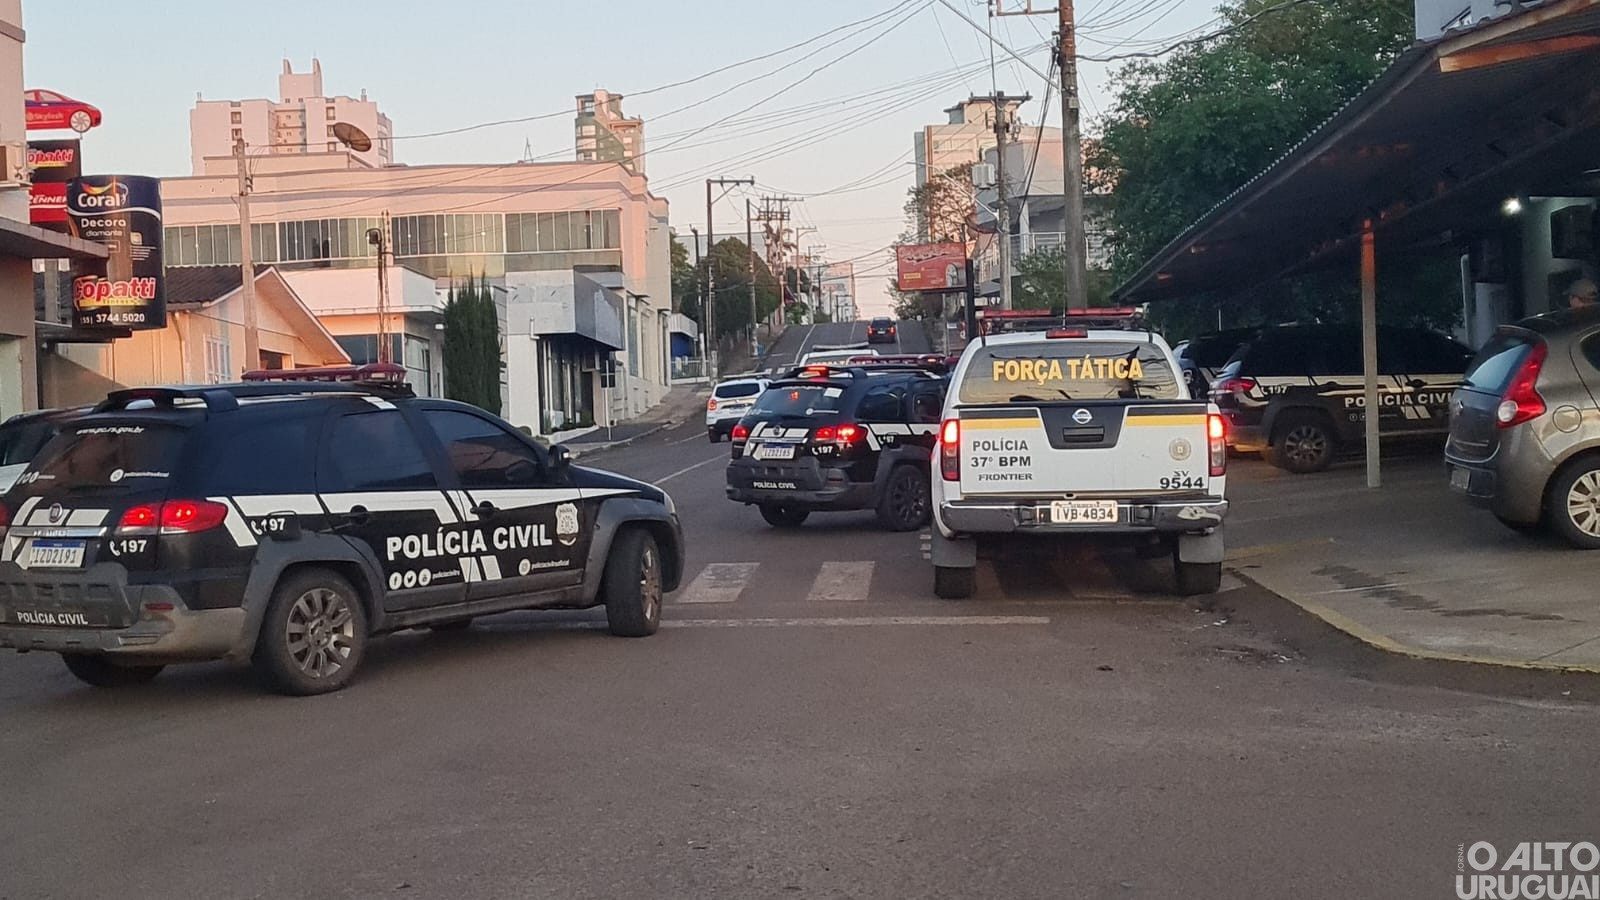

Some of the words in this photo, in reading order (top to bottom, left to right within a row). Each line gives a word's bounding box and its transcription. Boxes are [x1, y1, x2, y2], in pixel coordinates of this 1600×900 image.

[27, 149, 74, 164] opatti
[78, 193, 120, 207] Coral
[81, 218, 126, 228] Decora
[86, 229, 122, 237] diamante
[96, 313, 119, 323] 3744
[122, 313, 145, 322] 5020
[993, 359, 1062, 385] FORÇA
[1066, 354, 1143, 380] TÁTICA
[1345, 393, 1413, 408] POÍCIA
[972, 437, 1029, 452] POLÍCIA
[999, 456, 1031, 467] BPM
[978, 473, 1033, 481] FRONTIER
[1160, 477, 1205, 489] 9544
[753, 481, 777, 489] POLÍCIA
[261, 518, 285, 531] 197
[120, 540, 147, 553] 197
[386, 526, 487, 560] POLÍCIA
[492, 524, 553, 550] CIVIL
[17, 610, 56, 624] POLÍCIA
[58, 613, 88, 625] CIVIL
